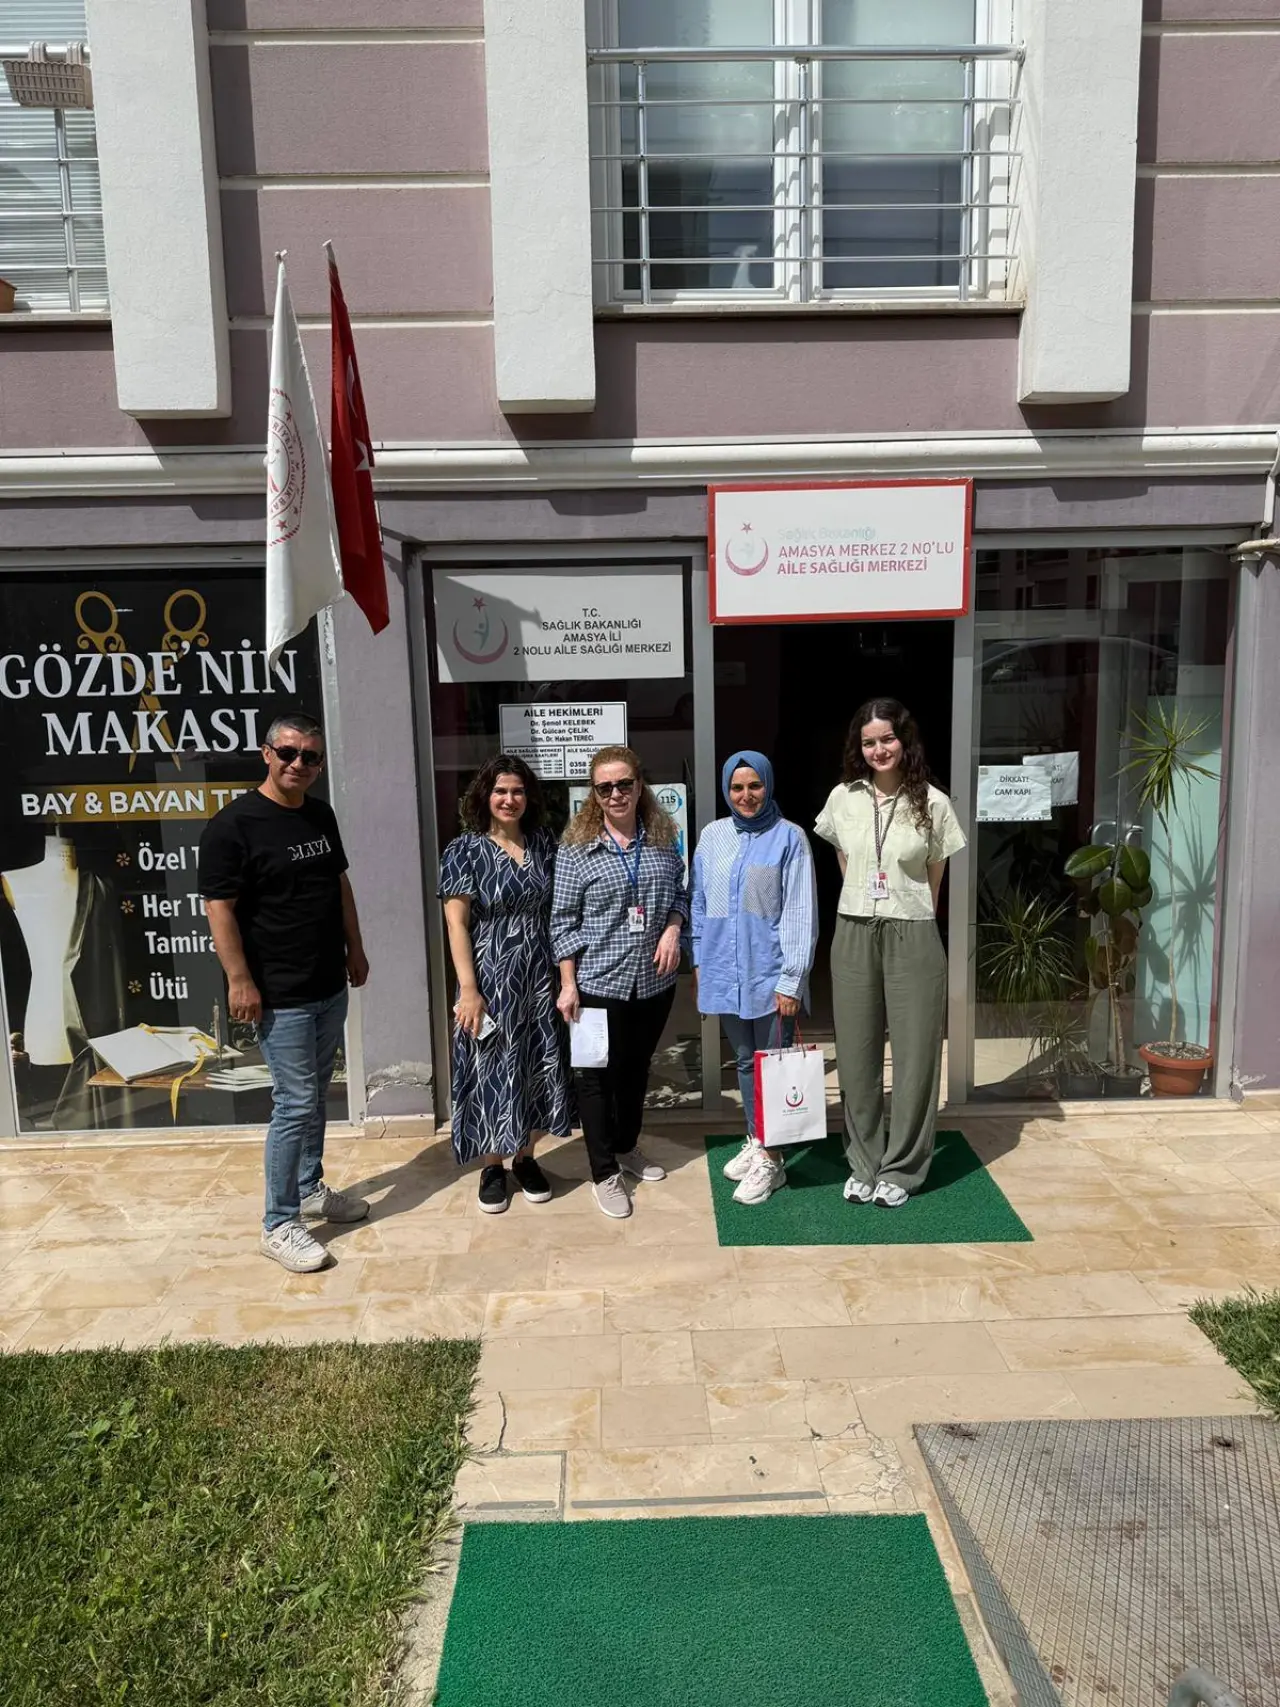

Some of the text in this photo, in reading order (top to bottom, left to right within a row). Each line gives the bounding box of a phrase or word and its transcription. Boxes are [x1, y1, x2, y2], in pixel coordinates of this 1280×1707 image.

[778, 545, 835, 558] AMASYA
[839, 543, 896, 557] MERKEZ
[900, 543, 908, 555] 2
[777, 557, 928, 575] AİLE SAĞLIĞI MERKEZİ
[582, 608, 601, 618] T.C.
[542, 618, 642, 631] SAĞLIK BAKANLIĞI
[563, 631, 622, 643] AMASYA İLİ
[513, 641, 672, 656] 2 NOLU AİLE SAĞLIĞI MERKEZİ
[524, 706, 603, 717] AİLE HEKİMLERİ
[41, 708, 263, 756] MAKASI
[568, 727, 590, 735] ÇELİK
[999, 774, 1029, 783] DİKKAT!
[994, 788, 1031, 796] CAM KAPI
[21, 792, 78, 816] BAY
[84, 791, 103, 814] &
[109, 788, 205, 813] BAYAN
[660, 795, 676, 804] 115
[138, 841, 186, 872] Özel
[142, 893, 181, 918] Her
[150, 972, 188, 1001] Ütü
